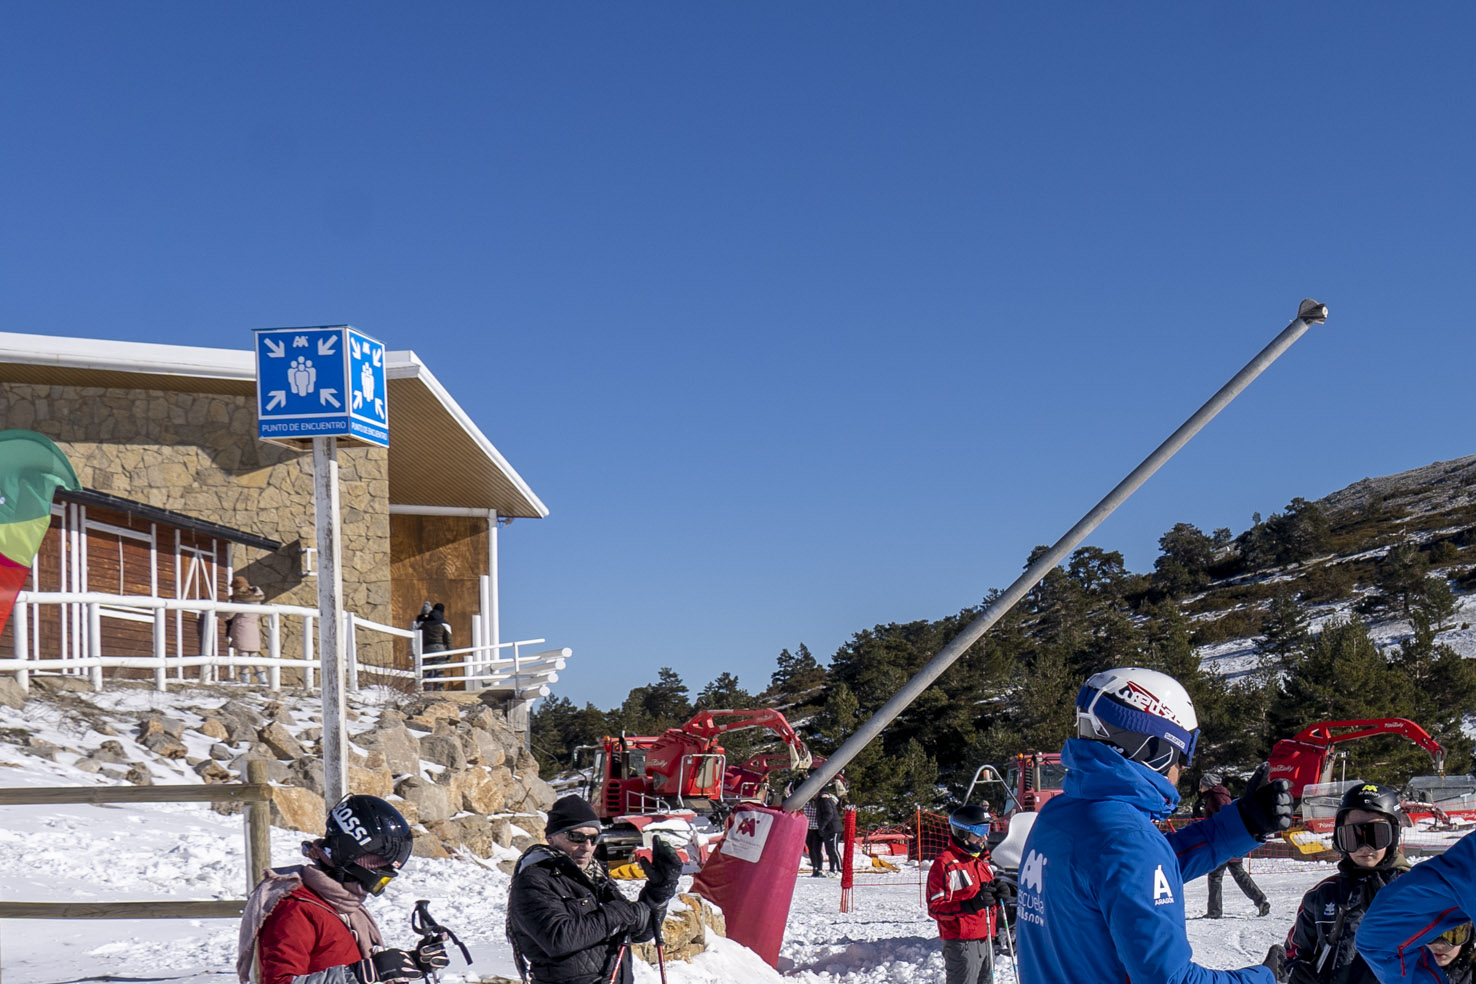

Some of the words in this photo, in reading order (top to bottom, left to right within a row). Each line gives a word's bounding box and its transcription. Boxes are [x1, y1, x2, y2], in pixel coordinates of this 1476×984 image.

[262, 423, 288, 432] PUNTO
[289, 423, 299, 431] DE
[301, 421, 347, 430] ENCUENTRO
[332, 802, 372, 846] ROSSI
